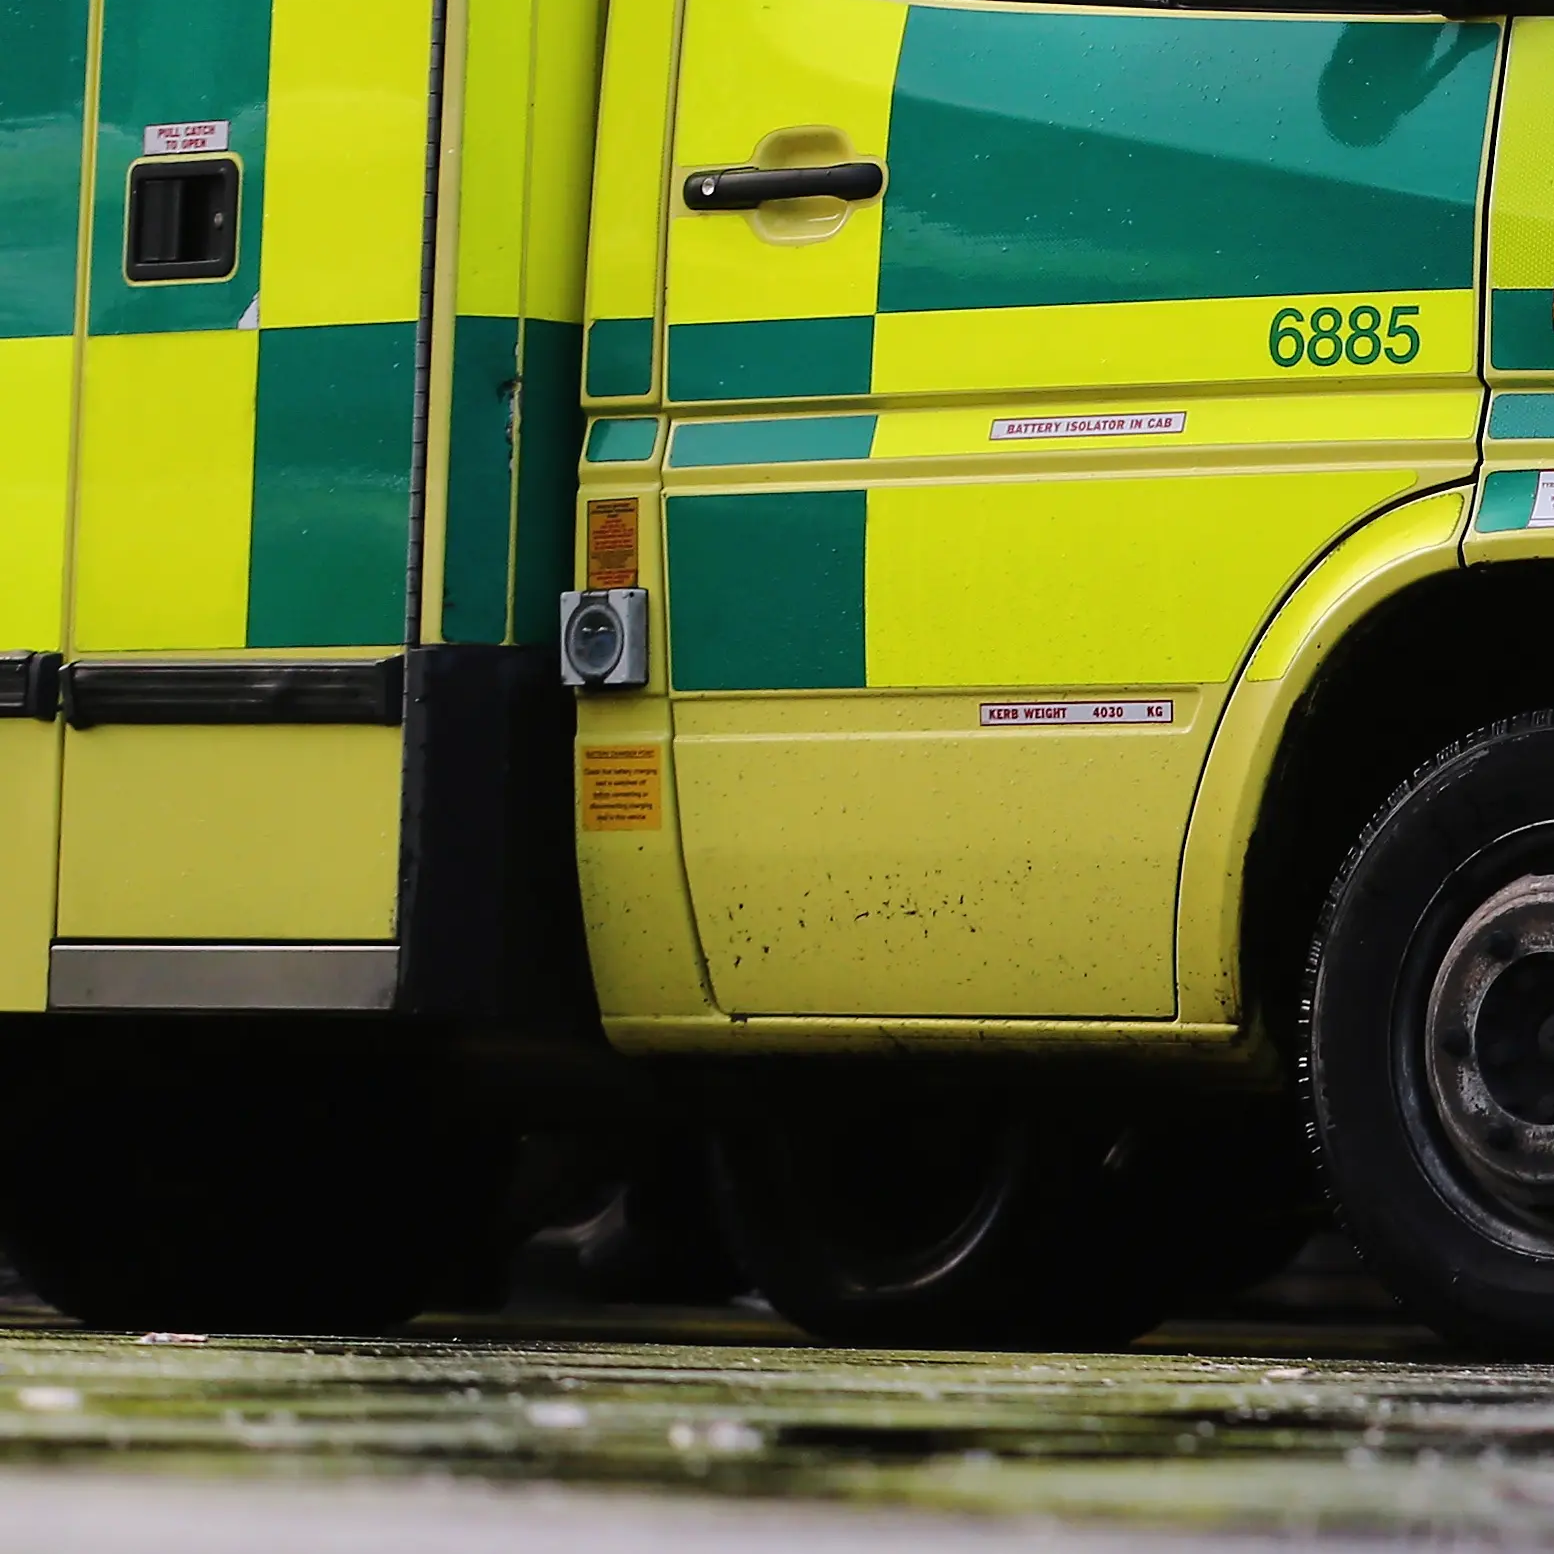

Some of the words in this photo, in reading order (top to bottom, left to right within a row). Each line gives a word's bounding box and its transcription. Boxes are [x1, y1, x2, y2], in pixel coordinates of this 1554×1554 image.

[157, 127, 181, 139] PULL
[184, 125, 216, 136] CATCH
[166, 140, 178, 150] TO
[182, 138, 207, 149] OPEN
[1269, 305, 1420, 367] 6885
[1007, 421, 1061, 435] BATTERY
[1065, 419, 1124, 433] ISOLATOR
[1129, 418, 1143, 430] IN
[1148, 417, 1172, 429] CAB
[988, 708, 1019, 720] KERB
[1023, 707, 1068, 719] WEIGHT
[1092, 706, 1123, 718] 4030
[1147, 705, 1163, 717] KG
